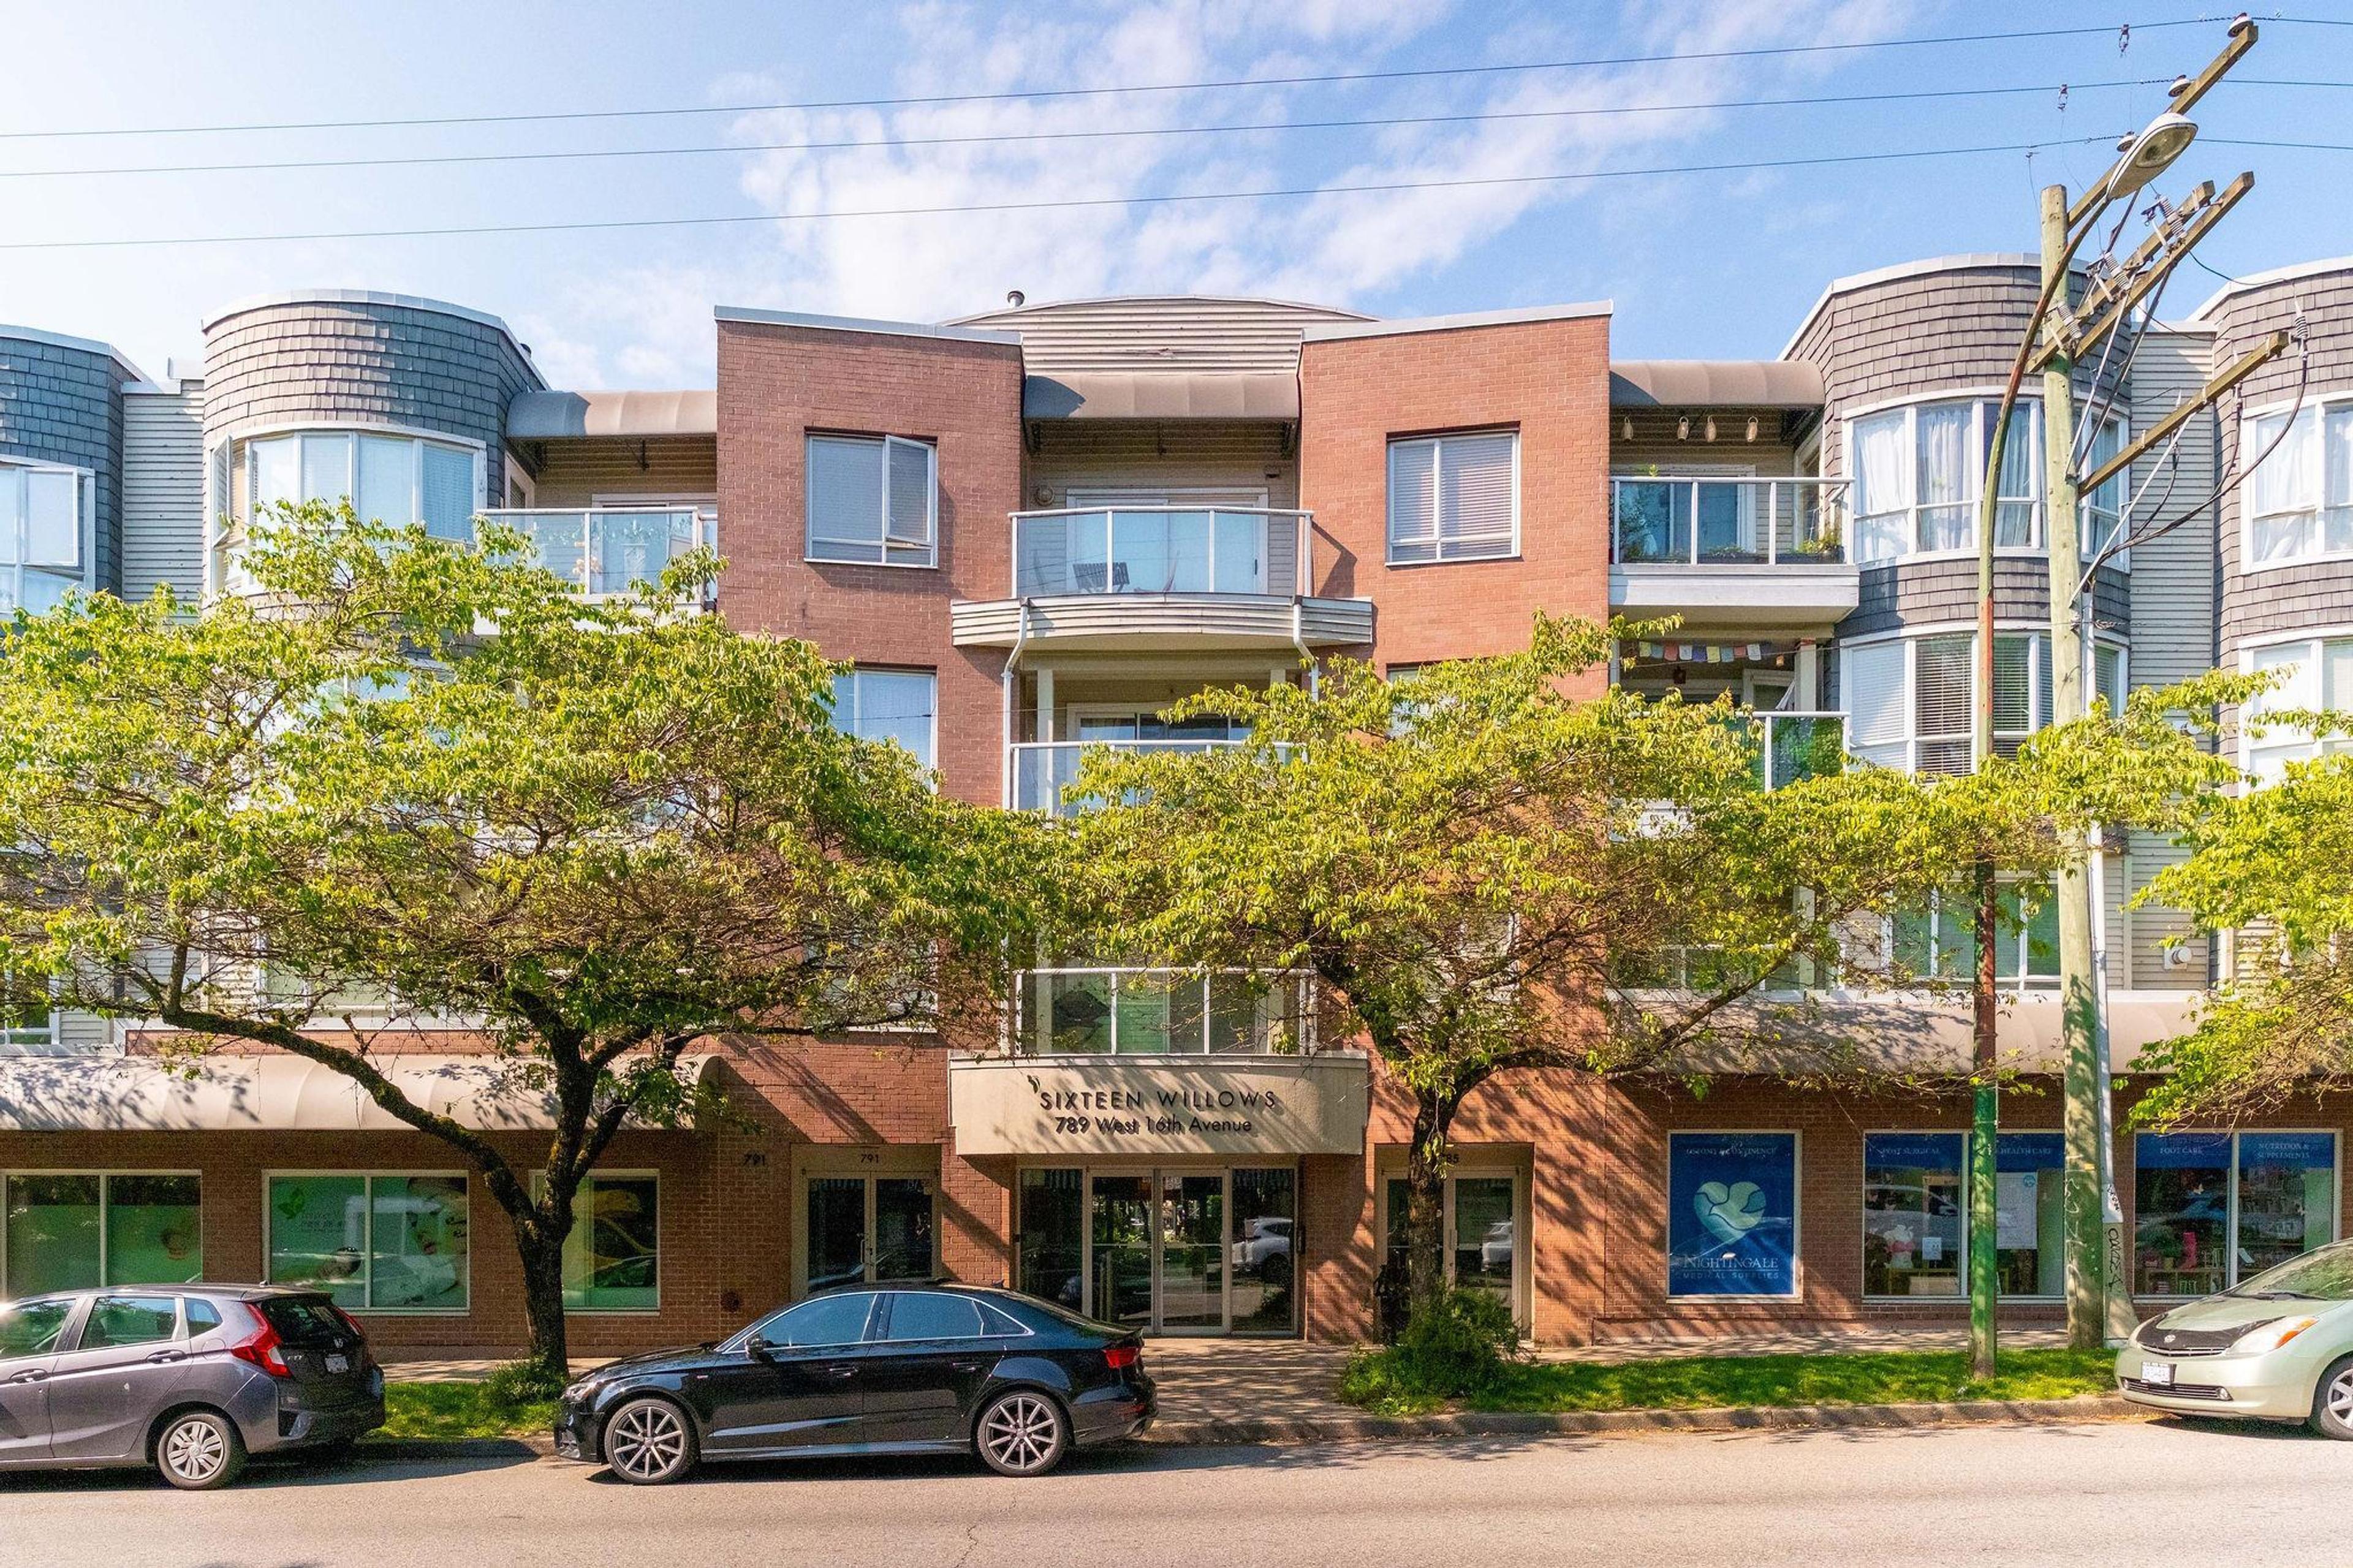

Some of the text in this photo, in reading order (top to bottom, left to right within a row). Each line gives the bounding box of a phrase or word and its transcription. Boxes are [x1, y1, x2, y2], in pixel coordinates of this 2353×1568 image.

[1040, 1091, 1275, 1109] SIXTEEN WILLOWS
[1055, 1115, 1252, 1133] 789 West 16th Avenue
[744, 1153, 765, 1165] 791
[861, 1153, 879, 1164] 791
[1683, 1256, 1779, 1268] NIGHTINGALE
